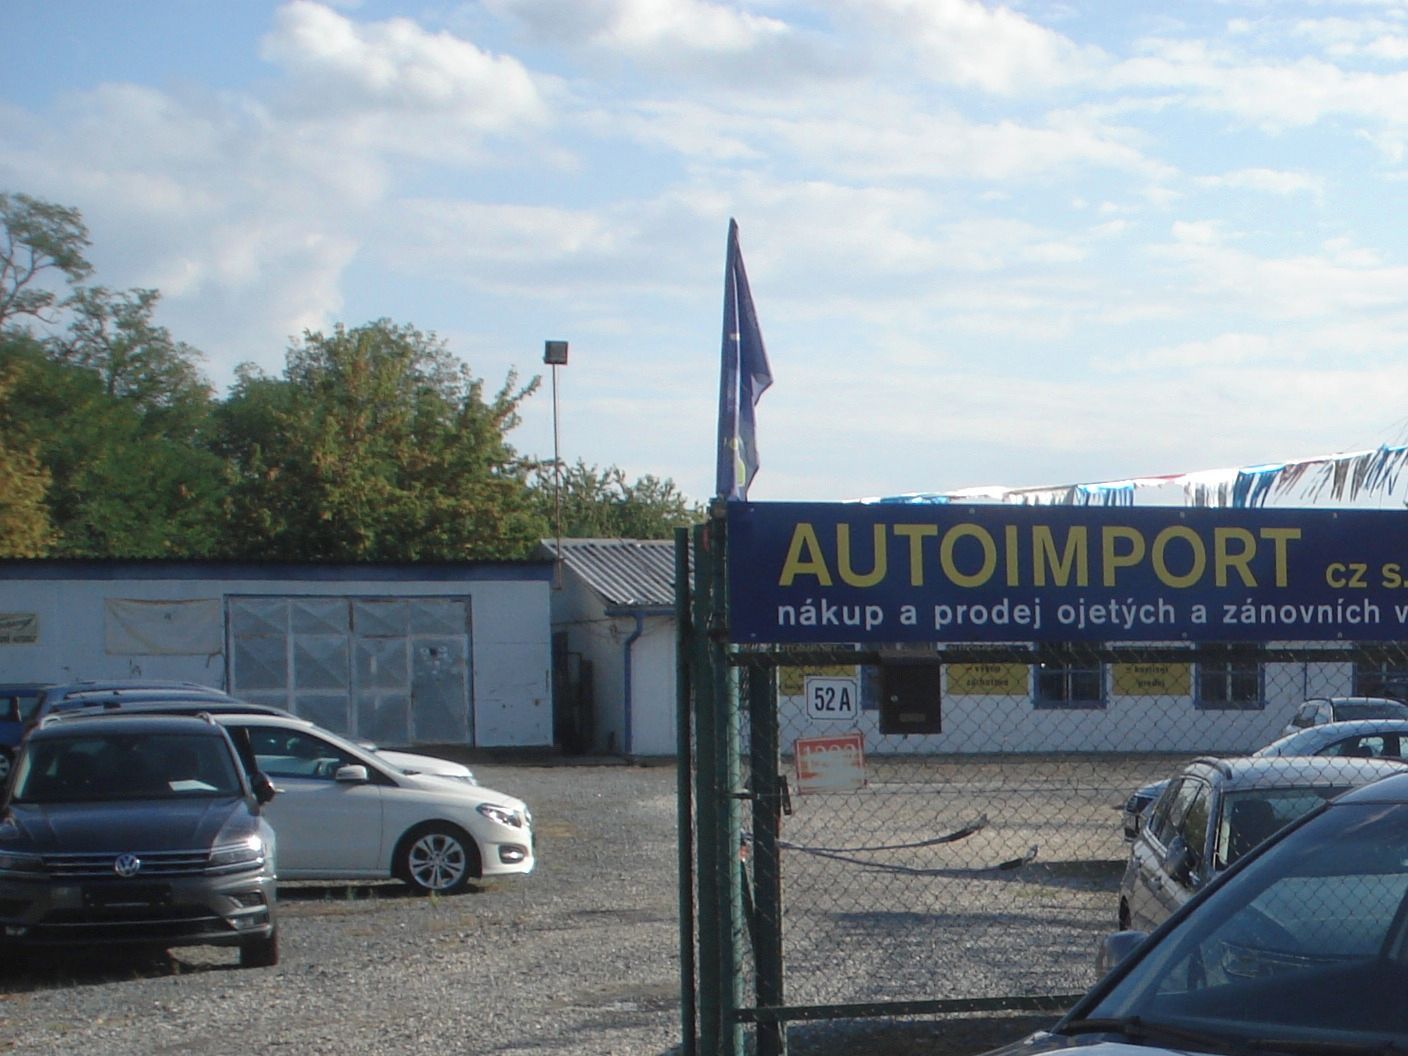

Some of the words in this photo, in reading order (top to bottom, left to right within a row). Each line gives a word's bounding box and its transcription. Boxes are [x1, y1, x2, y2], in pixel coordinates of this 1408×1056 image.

[778, 522, 1301, 589] AUTOIMPORT
[1326, 562, 1367, 588] cz
[777, 599, 883, 631] nákup
[900, 604, 917, 625] a
[934, 600, 1041, 630] prodej
[1057, 598, 1175, 630] ojetých
[1191, 604, 1207, 624] a
[1222, 598, 1381, 625] zánovních
